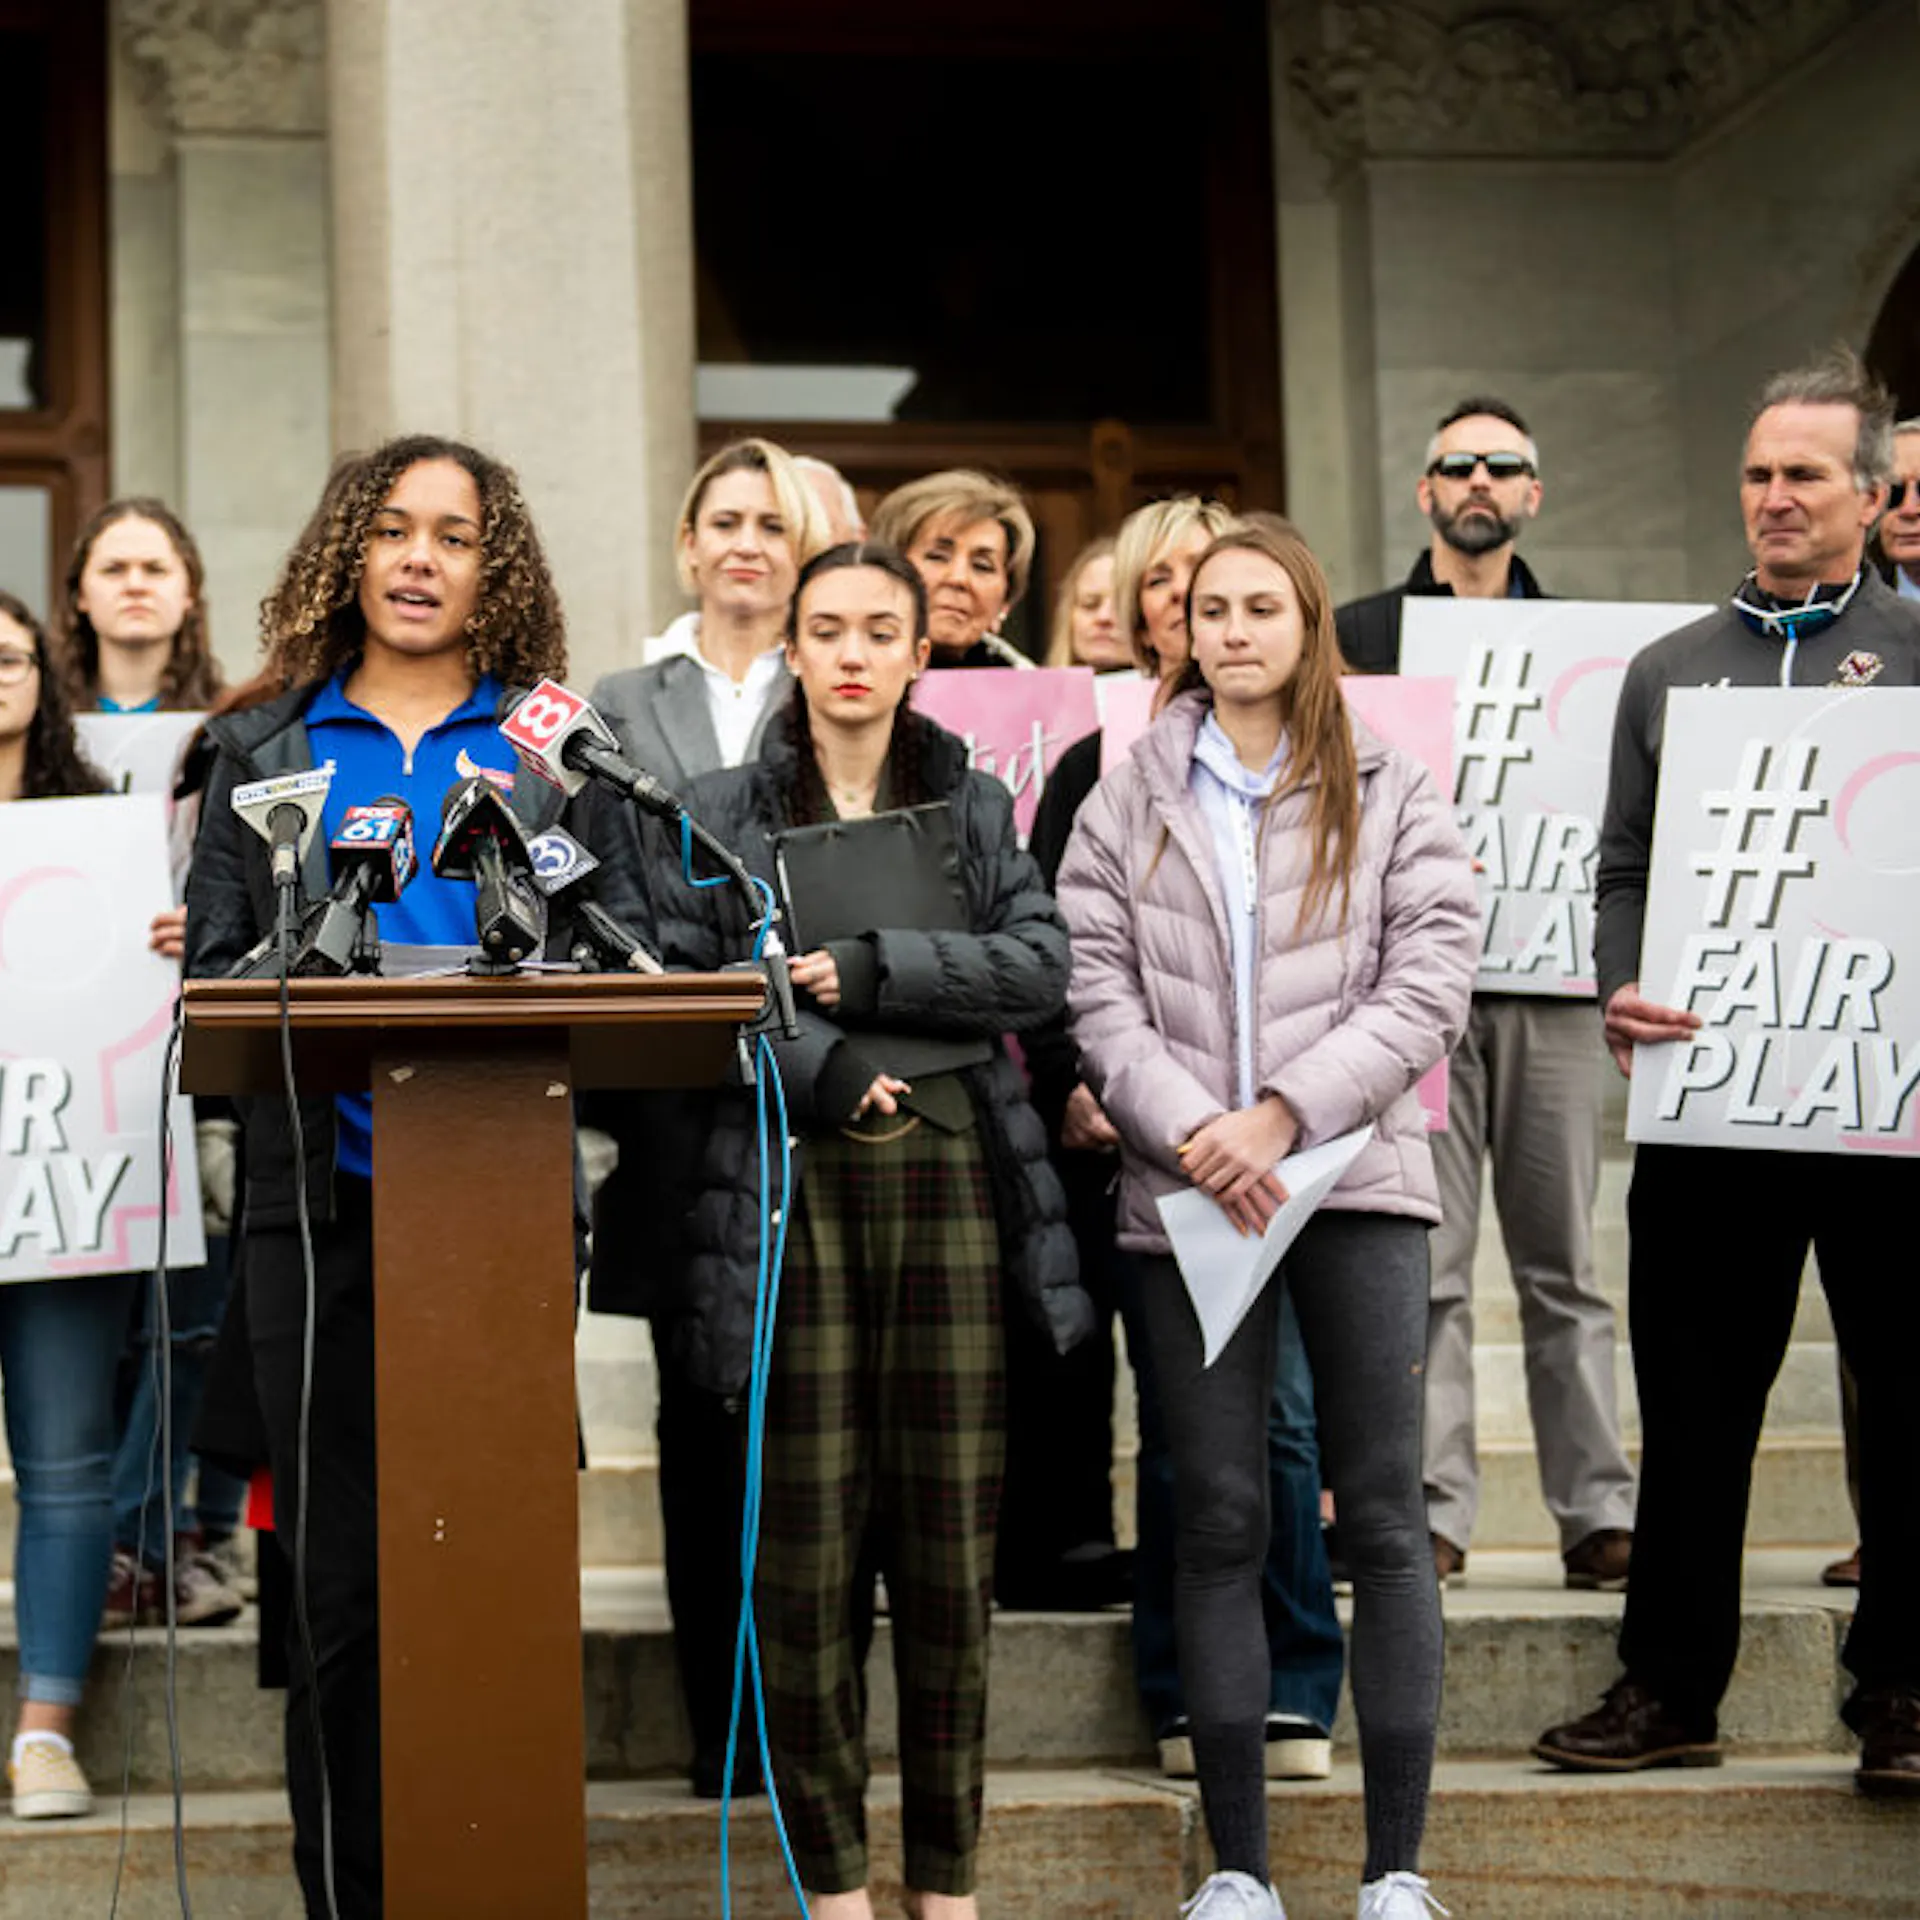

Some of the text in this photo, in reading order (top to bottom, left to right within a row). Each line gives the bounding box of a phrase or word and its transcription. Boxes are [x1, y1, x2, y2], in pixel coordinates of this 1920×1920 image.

[518, 694, 571, 738] 8
[343, 818, 393, 840] 61
[1455, 811, 1601, 893] AIR
[1689, 737, 1828, 928] #
[1479, 893, 1598, 976] LA
[1668, 934, 1895, 1033] FAIR
[0, 1056, 71, 1156] R
[1656, 1029, 1920, 1132] PLAY
[0, 1150, 133, 1257] AY
